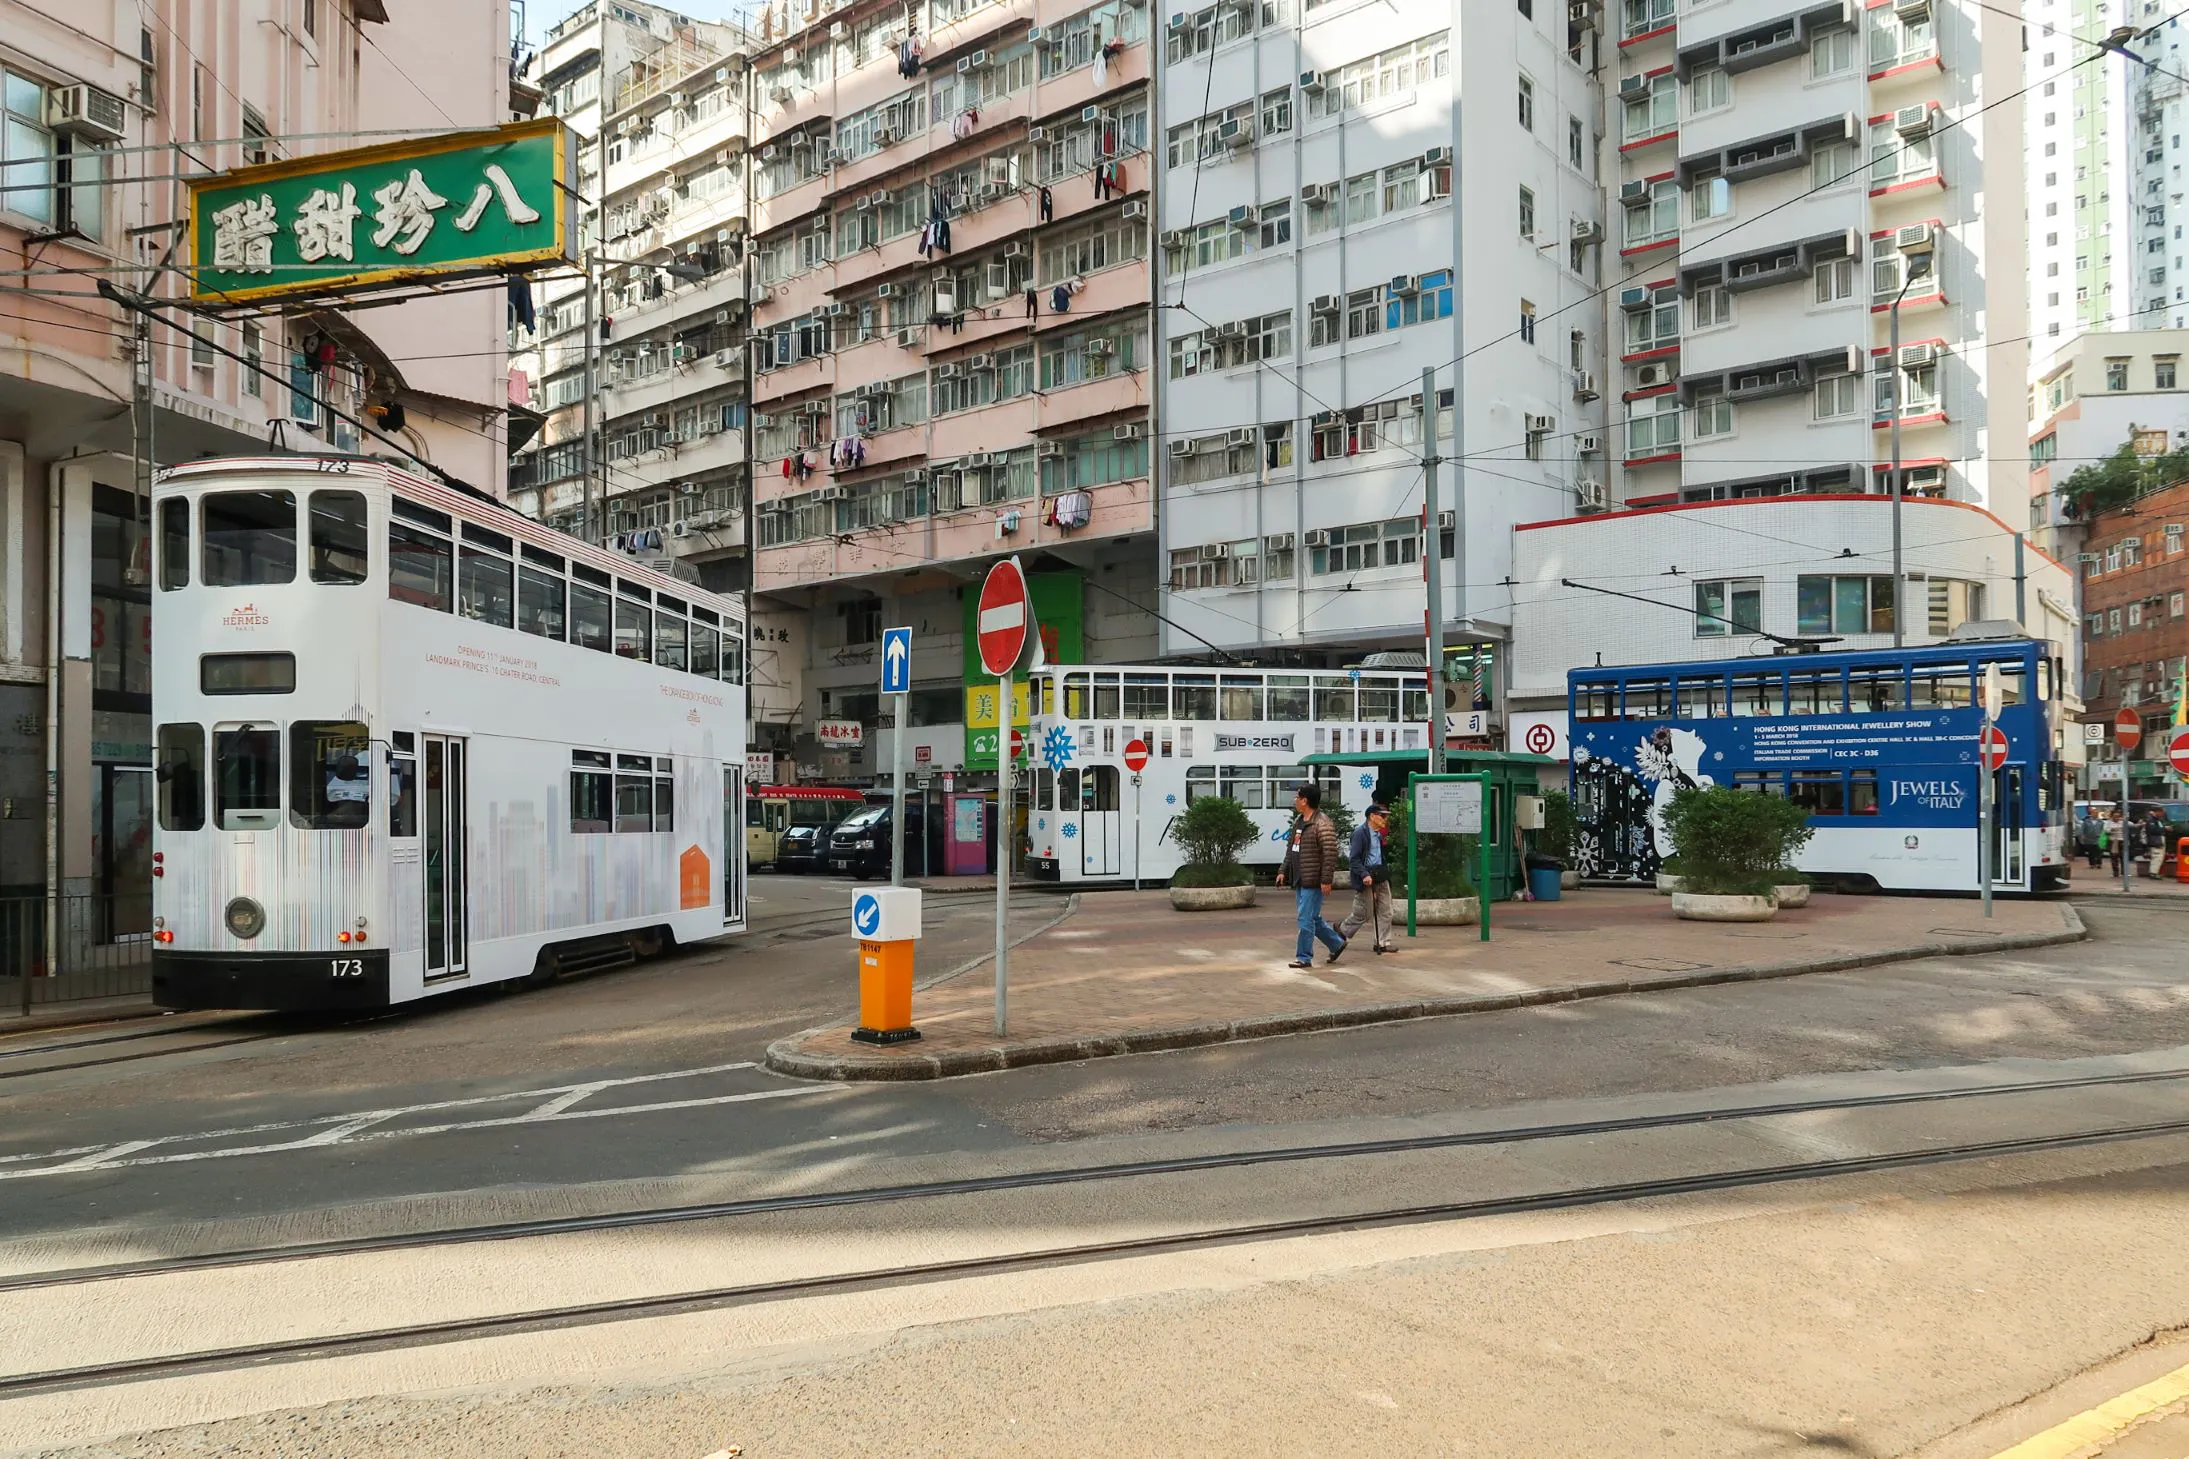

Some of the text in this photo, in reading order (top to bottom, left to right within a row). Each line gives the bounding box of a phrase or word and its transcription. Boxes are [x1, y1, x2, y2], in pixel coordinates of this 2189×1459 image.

[316, 458, 350, 474] 173
[457, 645, 486, 659] OPENING
[499, 655, 524, 667] JANUARY
[425, 653, 461, 668] LANDMARK
[499, 667, 521, 680] CHATER
[538, 674, 561, 687] CENTRAL
[1800, 723, 1859, 731] INTERNATIONAL
[1861, 721, 1905, 730] JEWELLERY
[1905, 720, 1932, 728] SHOW
[1864, 749, 1879, 757] D36
[1889, 780, 1960, 806] JEWELS
[1917, 796, 1964, 809] OF ITALY
[1041, 861, 1050, 869] 55
[331, 959, 363, 977] 173
